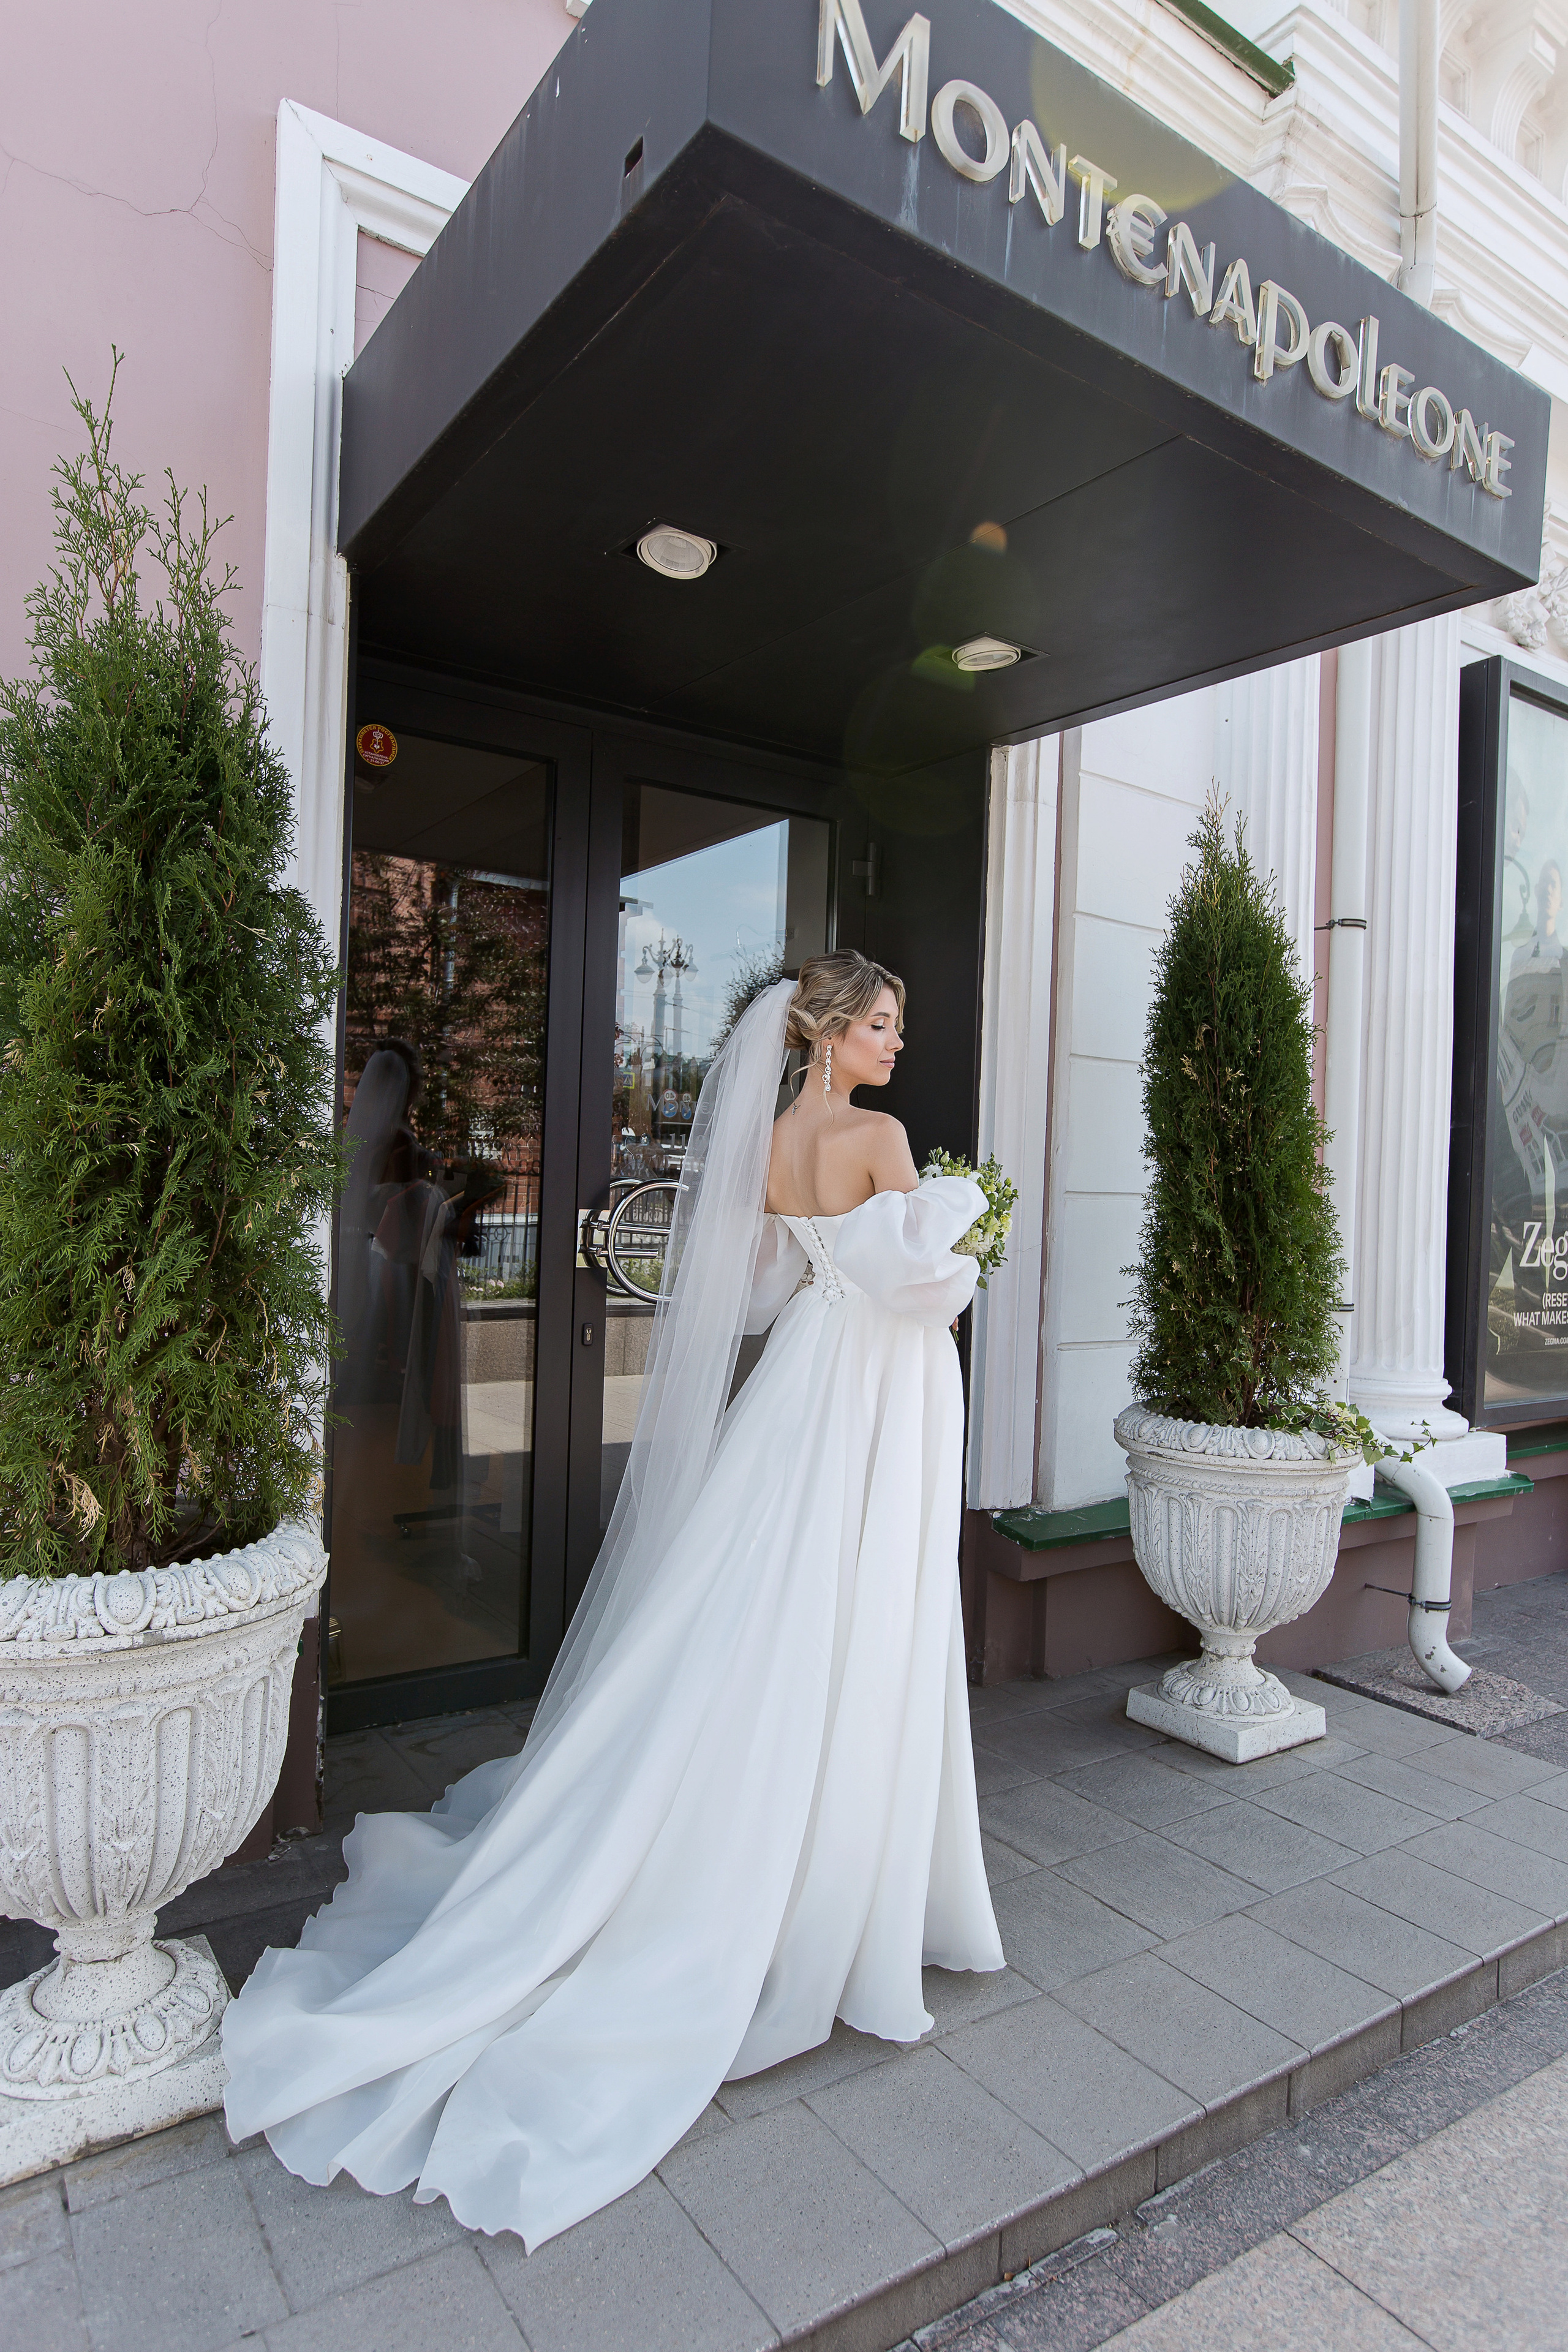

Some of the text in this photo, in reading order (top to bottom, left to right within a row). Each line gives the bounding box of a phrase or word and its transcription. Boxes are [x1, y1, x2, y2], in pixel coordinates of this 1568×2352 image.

[1519, 1221, 1568, 1281] Zeg
[1542, 1292, 1568, 1310] (RESE
[1513, 1310, 1568, 1327] WHAT MAKE
